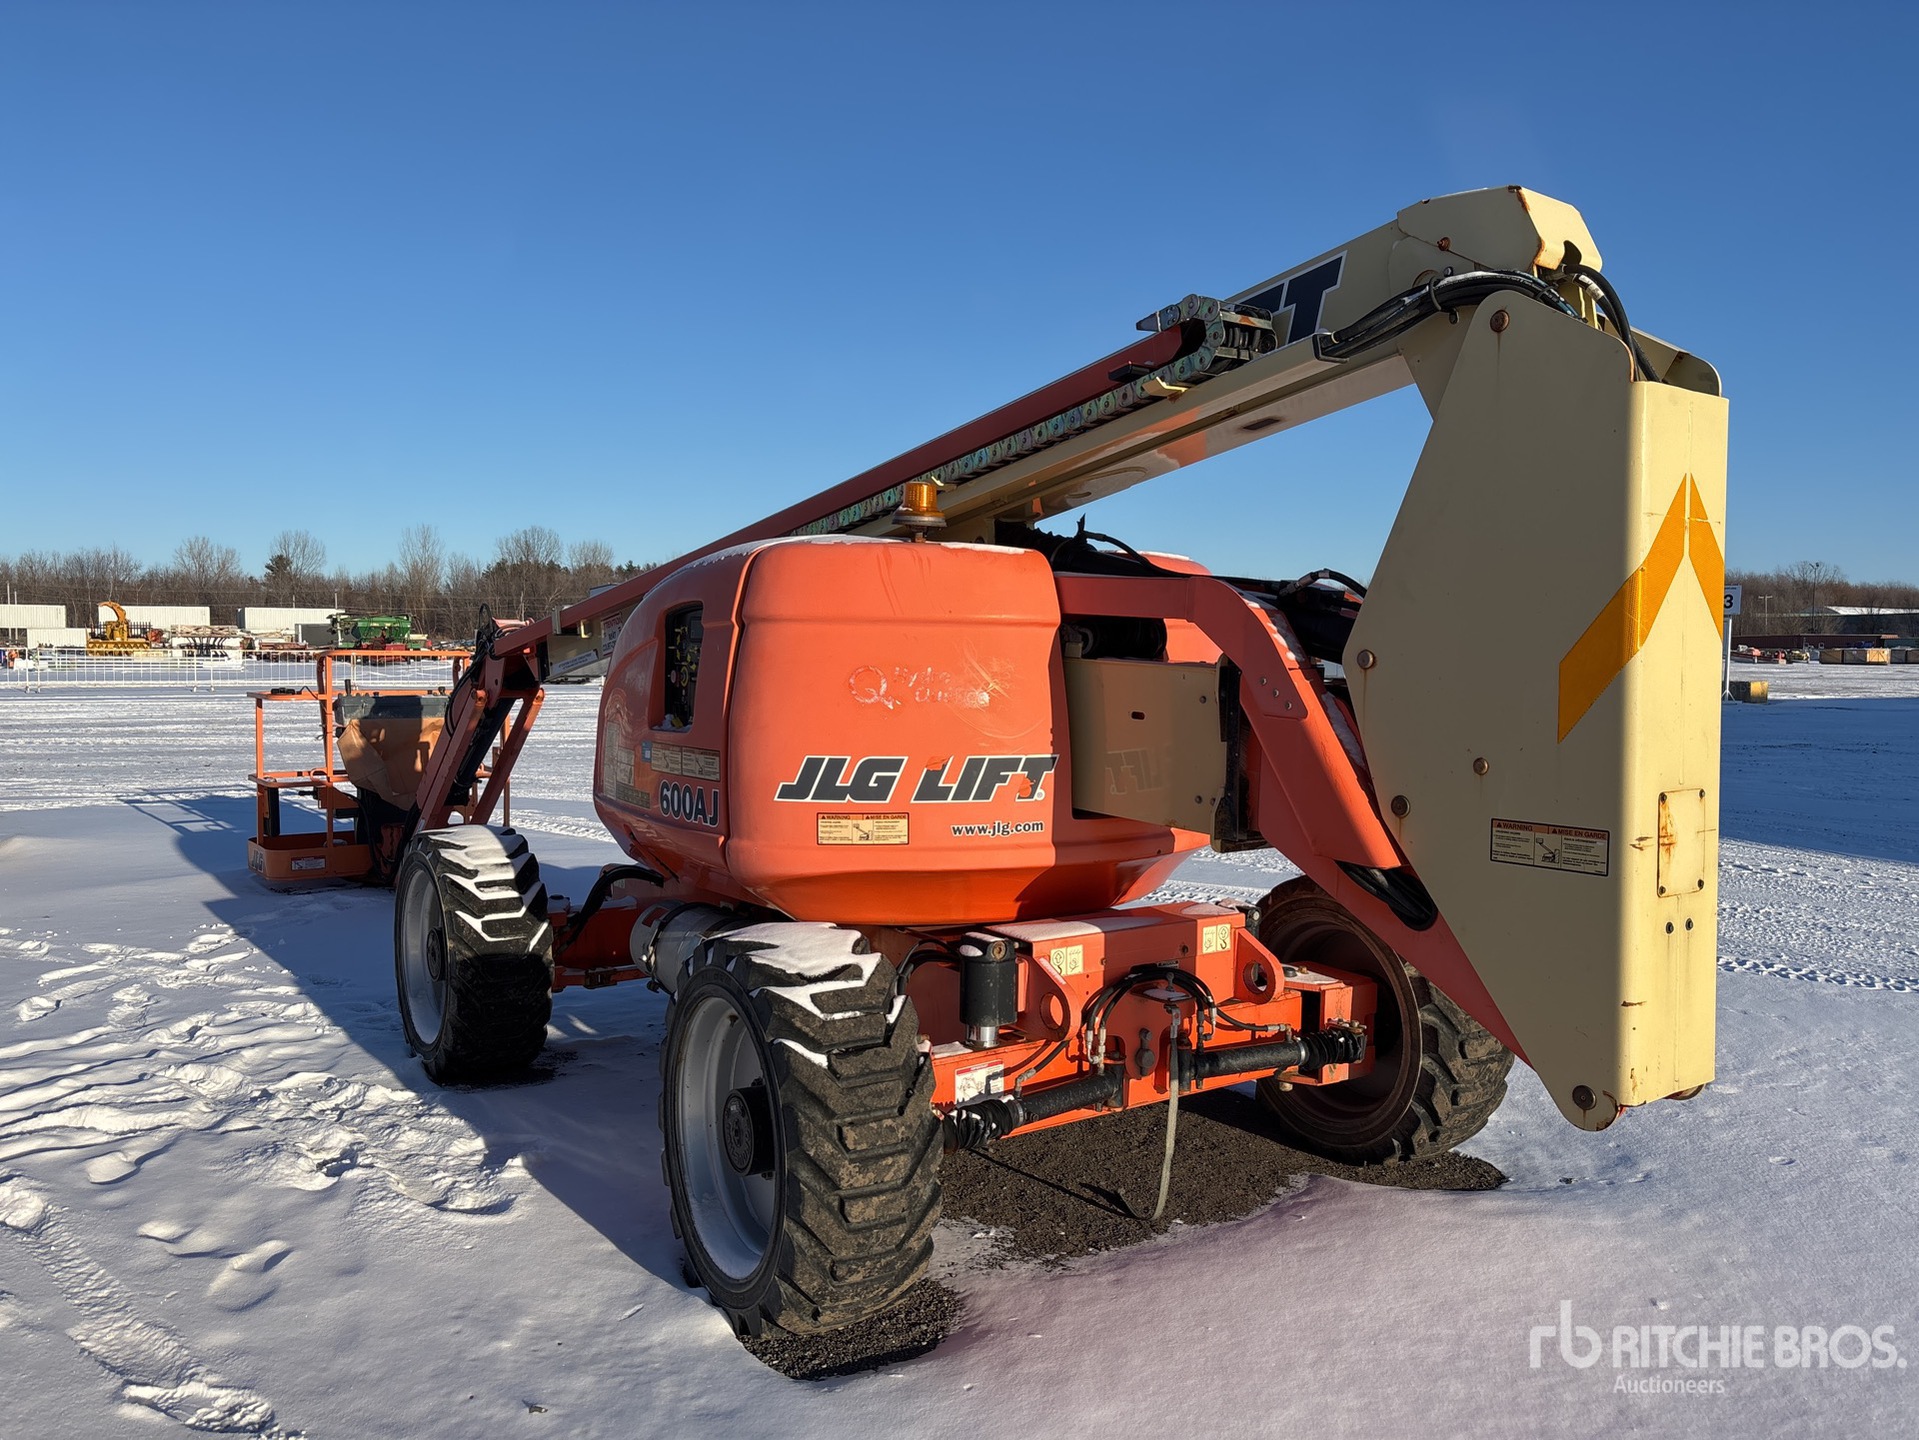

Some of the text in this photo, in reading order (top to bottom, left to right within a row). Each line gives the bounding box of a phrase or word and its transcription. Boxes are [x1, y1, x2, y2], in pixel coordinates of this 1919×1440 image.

[773, 755, 909, 803] JLG
[910, 754, 1060, 804] LIFT
[660, 779, 720, 828] 600AJ
[951, 820, 1045, 838] www.jlg.com
[1502, 822, 1607, 840] WARNING MISE EN GARDE
